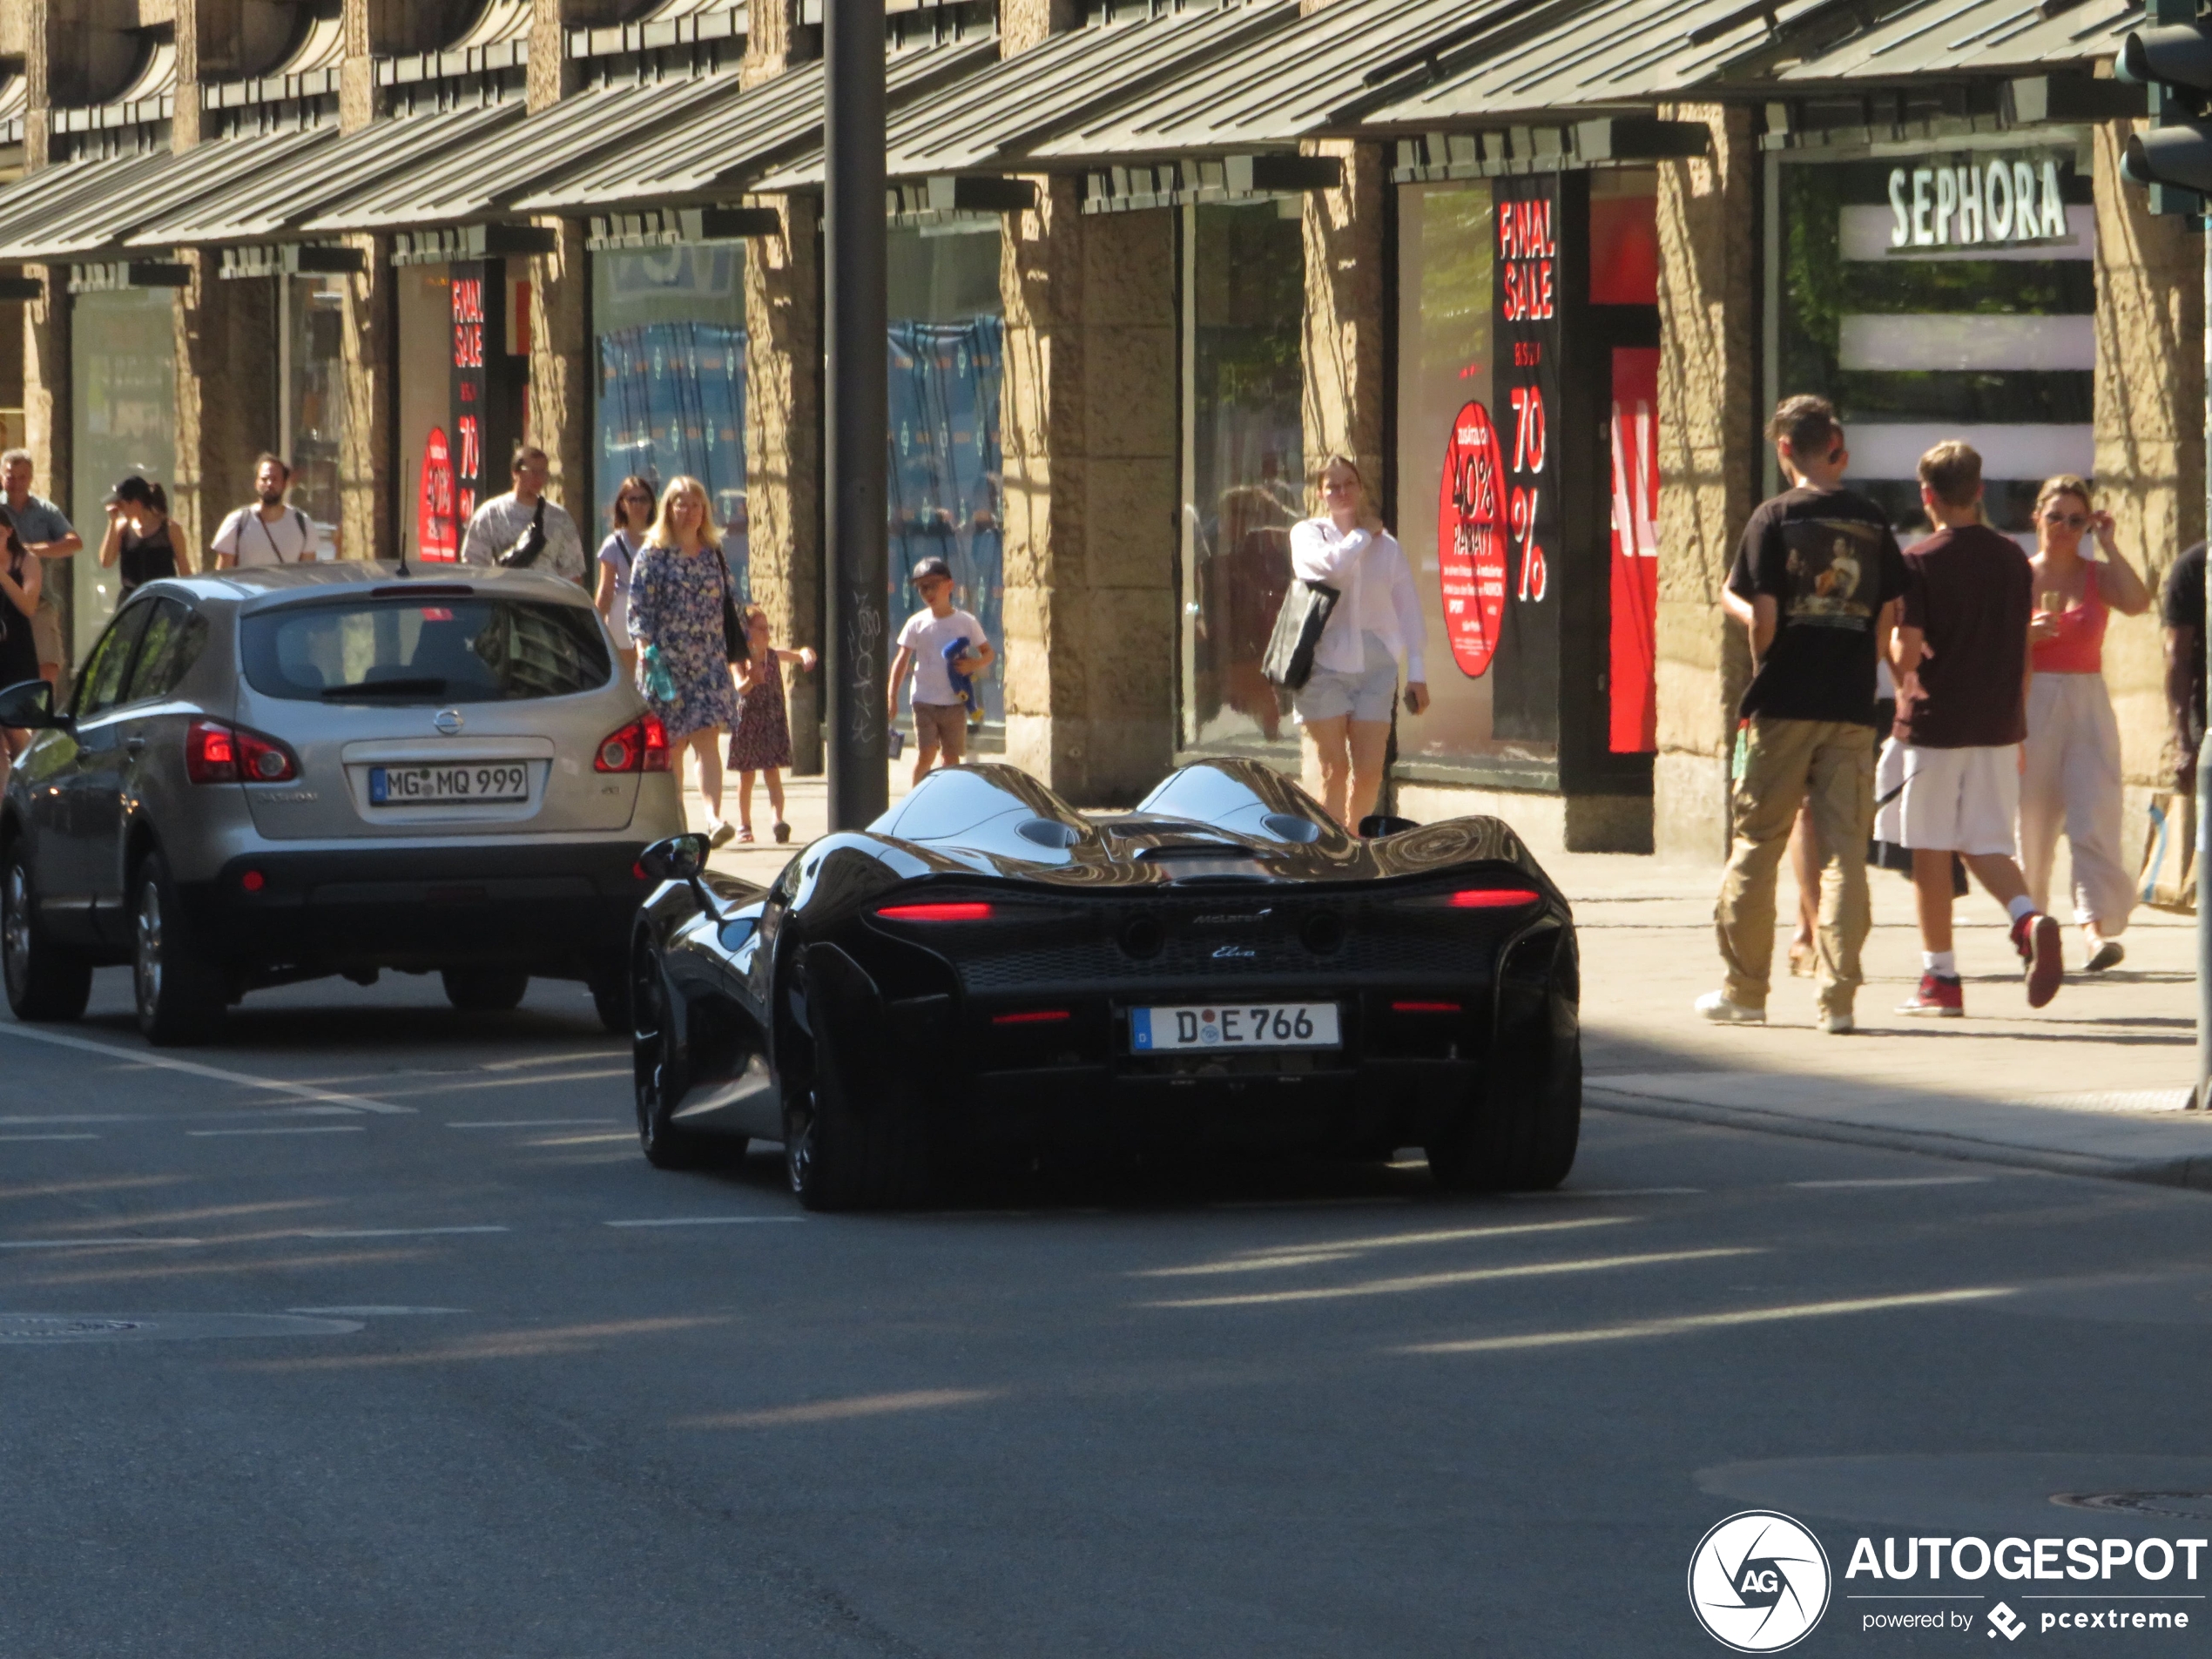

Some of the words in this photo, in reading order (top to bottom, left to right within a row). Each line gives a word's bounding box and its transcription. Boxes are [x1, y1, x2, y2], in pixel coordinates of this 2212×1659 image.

[1499, 199, 1555, 260] FINAL
[1888, 158, 2067, 247] SEPHORA
[451, 279, 483, 323] FINAL
[1502, 260, 1554, 321] SALE
[454, 323, 482, 368] SALE
[459, 413, 480, 481] 70
[1510, 384, 1546, 474] 70
[1453, 453, 1494, 519] 40%
[1453, 523, 1493, 556] RABATT
[1510, 484, 1546, 603] %
[387, 772, 419, 796] MG
[437, 770, 470, 794] MQ
[476, 768, 523, 794] 999
[1212, 946, 1256, 958] Elva
[1176, 1011, 1198, 1043] D
[1221, 1009, 1244, 1042] E
[1250, 1008, 1313, 1041] 766
